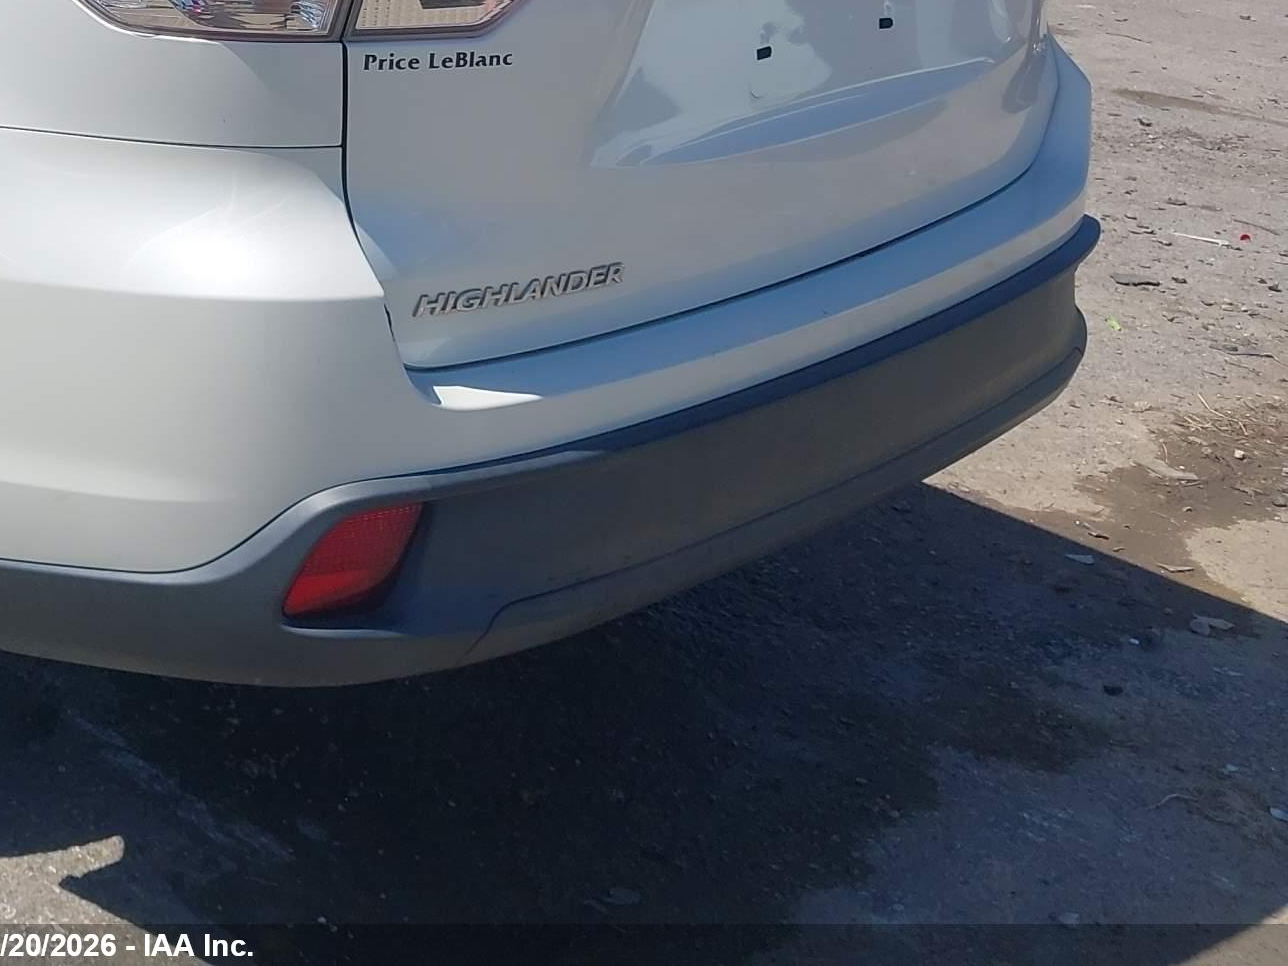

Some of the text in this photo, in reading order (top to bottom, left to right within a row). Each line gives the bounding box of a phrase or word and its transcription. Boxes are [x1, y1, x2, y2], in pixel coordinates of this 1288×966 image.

[363, 51, 513, 71] Price LeBlanc
[412, 261, 625, 317] HIGHLANDER
